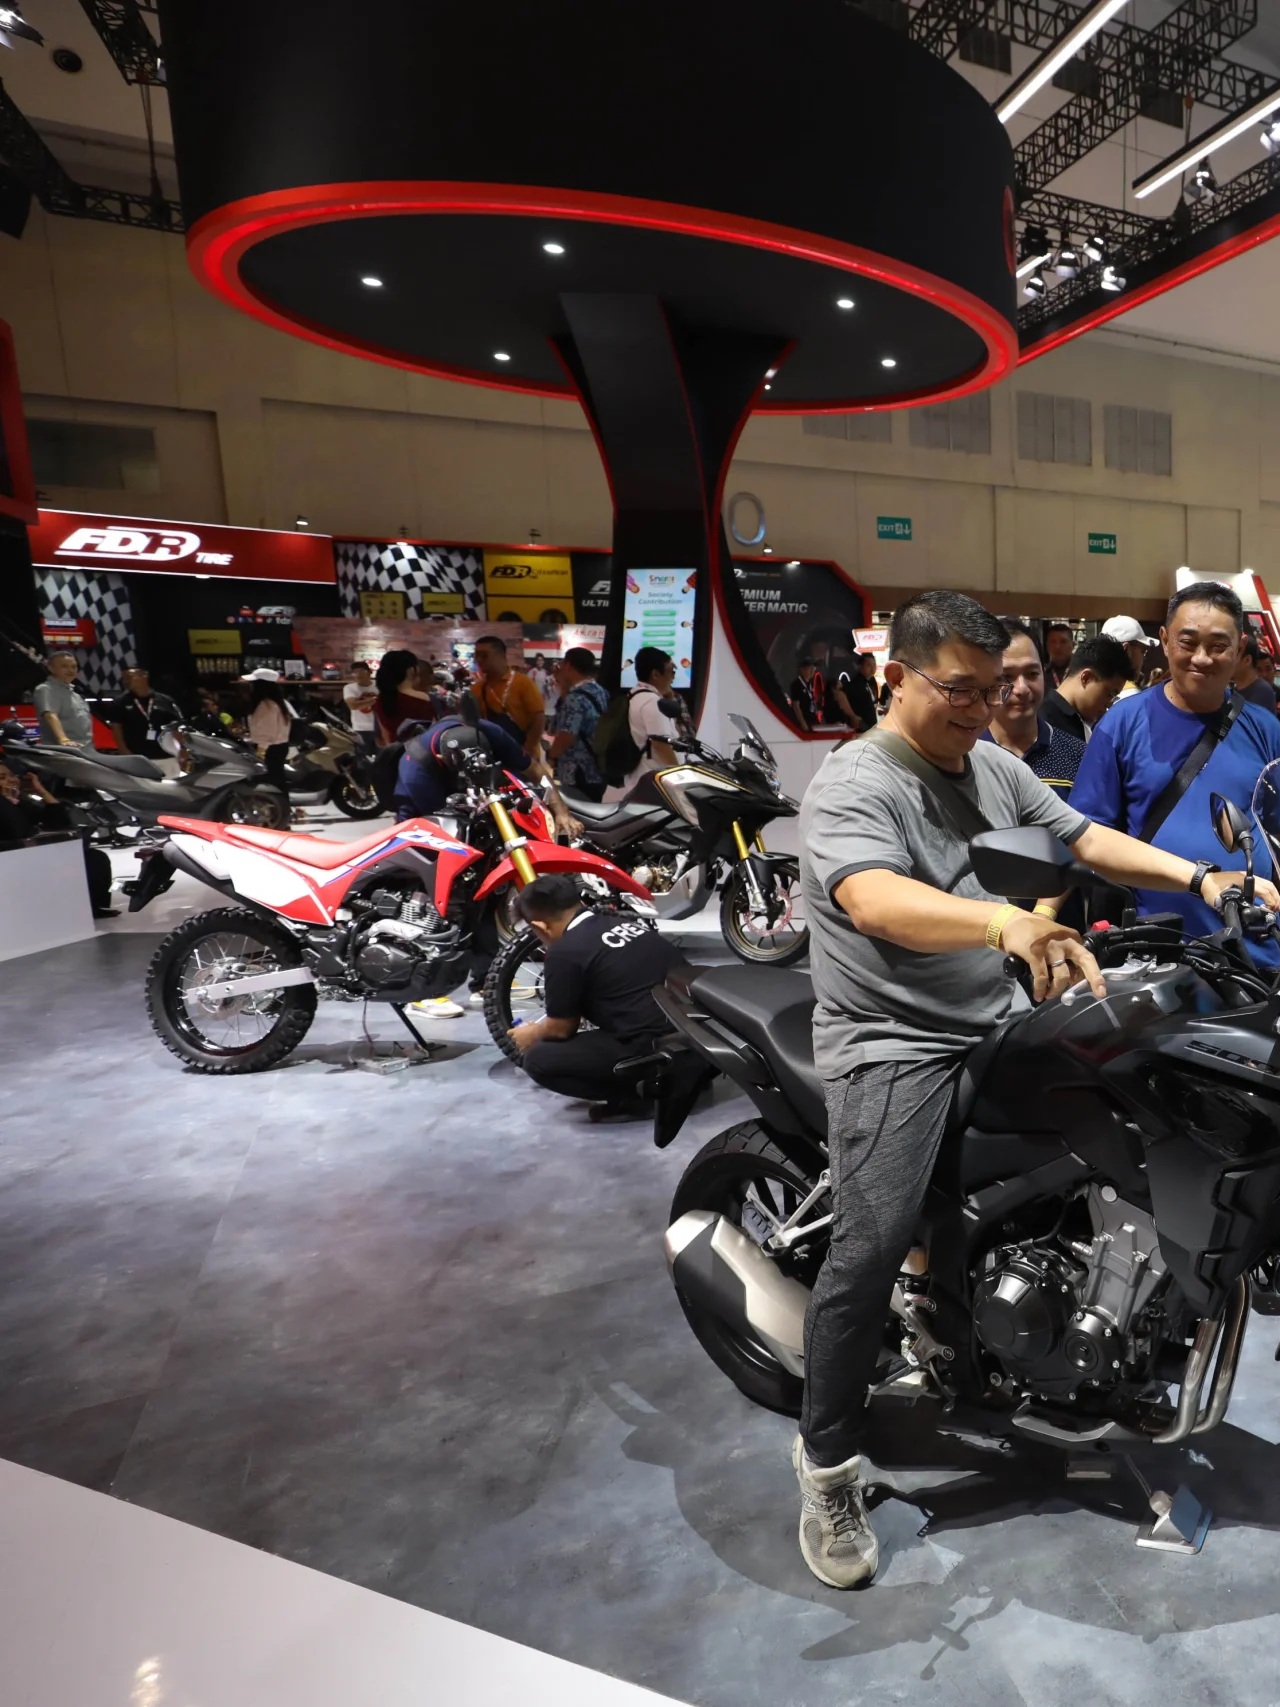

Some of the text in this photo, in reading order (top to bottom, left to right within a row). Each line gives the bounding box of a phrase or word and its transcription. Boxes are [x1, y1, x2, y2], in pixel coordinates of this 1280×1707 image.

[55, 526, 234, 565] FDR TIRE
[489, 565, 532, 579] FDR
[767, 603, 808, 613] MATIC
